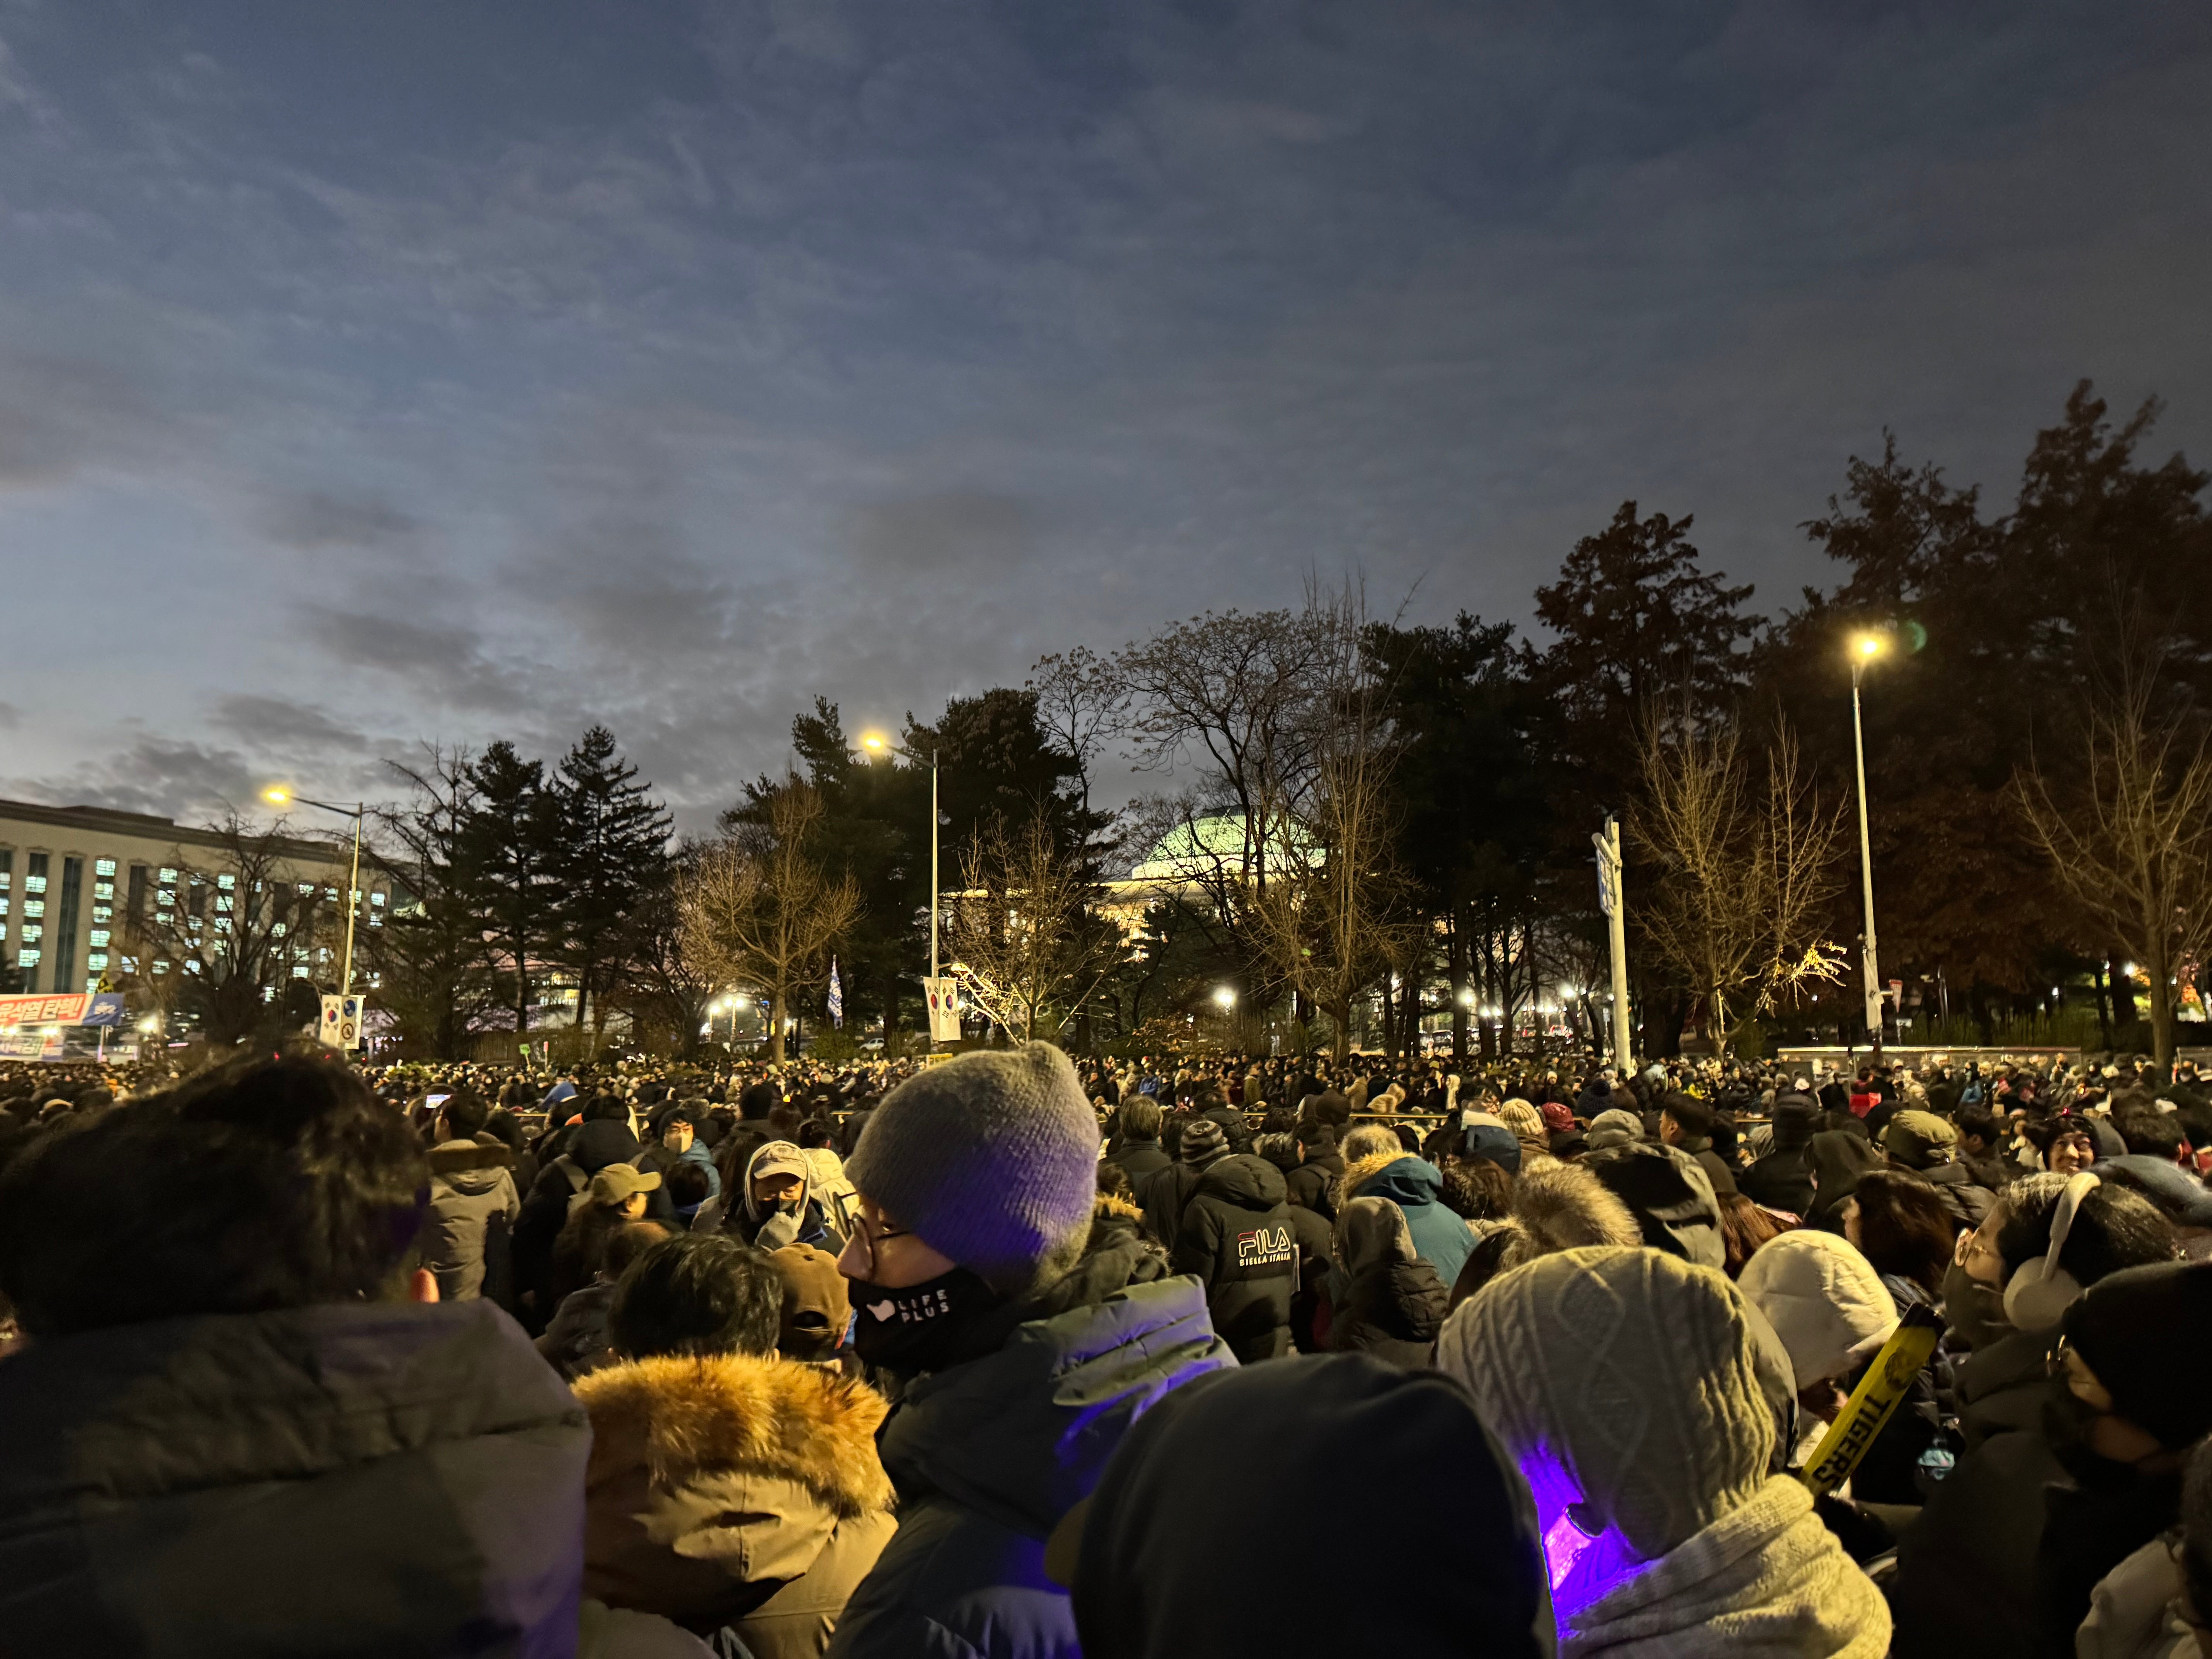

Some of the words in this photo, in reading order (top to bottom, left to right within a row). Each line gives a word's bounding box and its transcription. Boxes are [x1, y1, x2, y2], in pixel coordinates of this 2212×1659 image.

[0, 1000, 45, 1022] 윤석열
[40, 996, 84, 1019] 탄핵!
[1238, 1226, 1291, 1257] FILA
[1239, 1255, 1267, 1266] BIELLA
[1270, 1252, 1291, 1262] ITALIA
[898, 1289, 947, 1310] LIFE
[901, 1302, 949, 1323] PLUS
[1813, 1395, 1893, 1485] TIGERS
